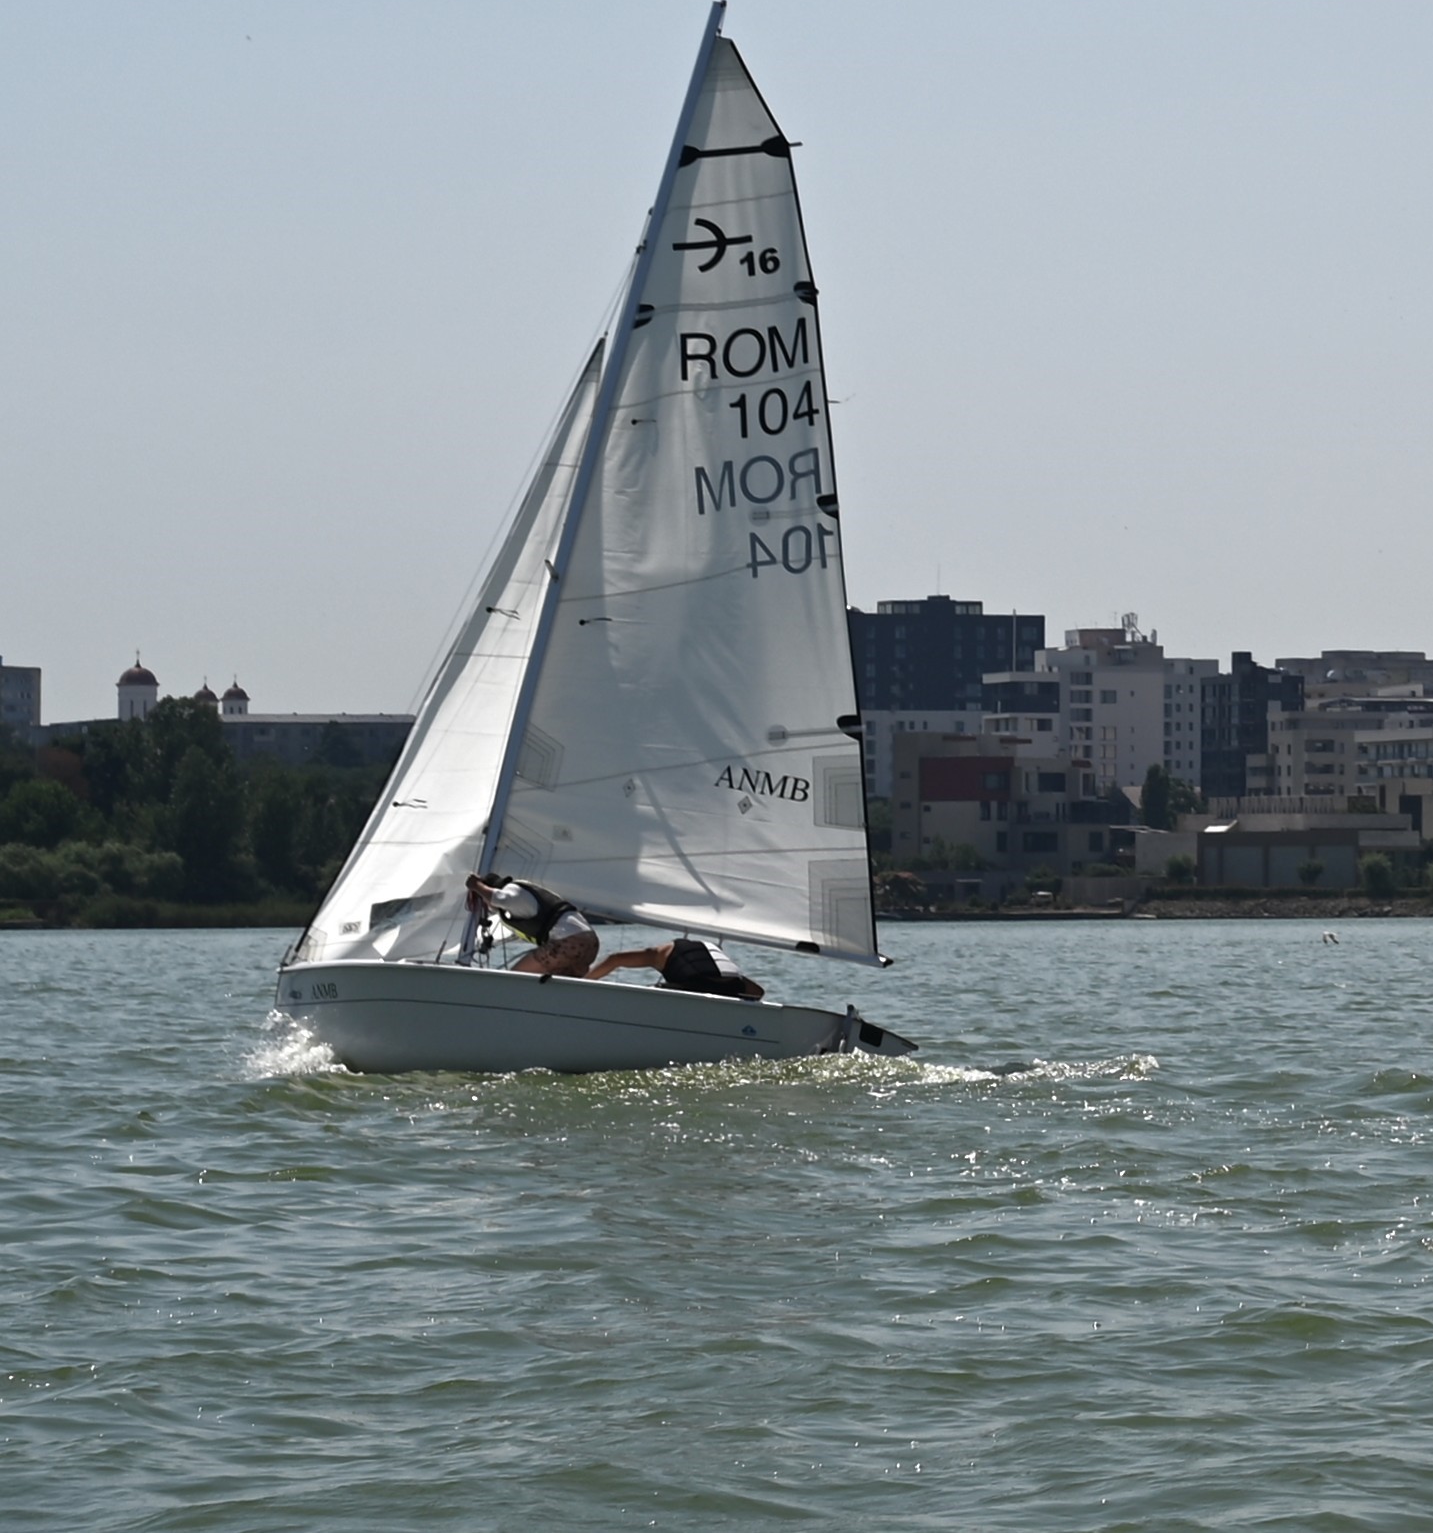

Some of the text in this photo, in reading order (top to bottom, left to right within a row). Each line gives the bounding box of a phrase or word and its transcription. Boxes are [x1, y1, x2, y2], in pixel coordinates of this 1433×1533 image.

[739, 247, 781, 278] 16
[679, 316, 810, 382] ROM
[728, 379, 820, 439] 104
[714, 764, 810, 802] ANMB
